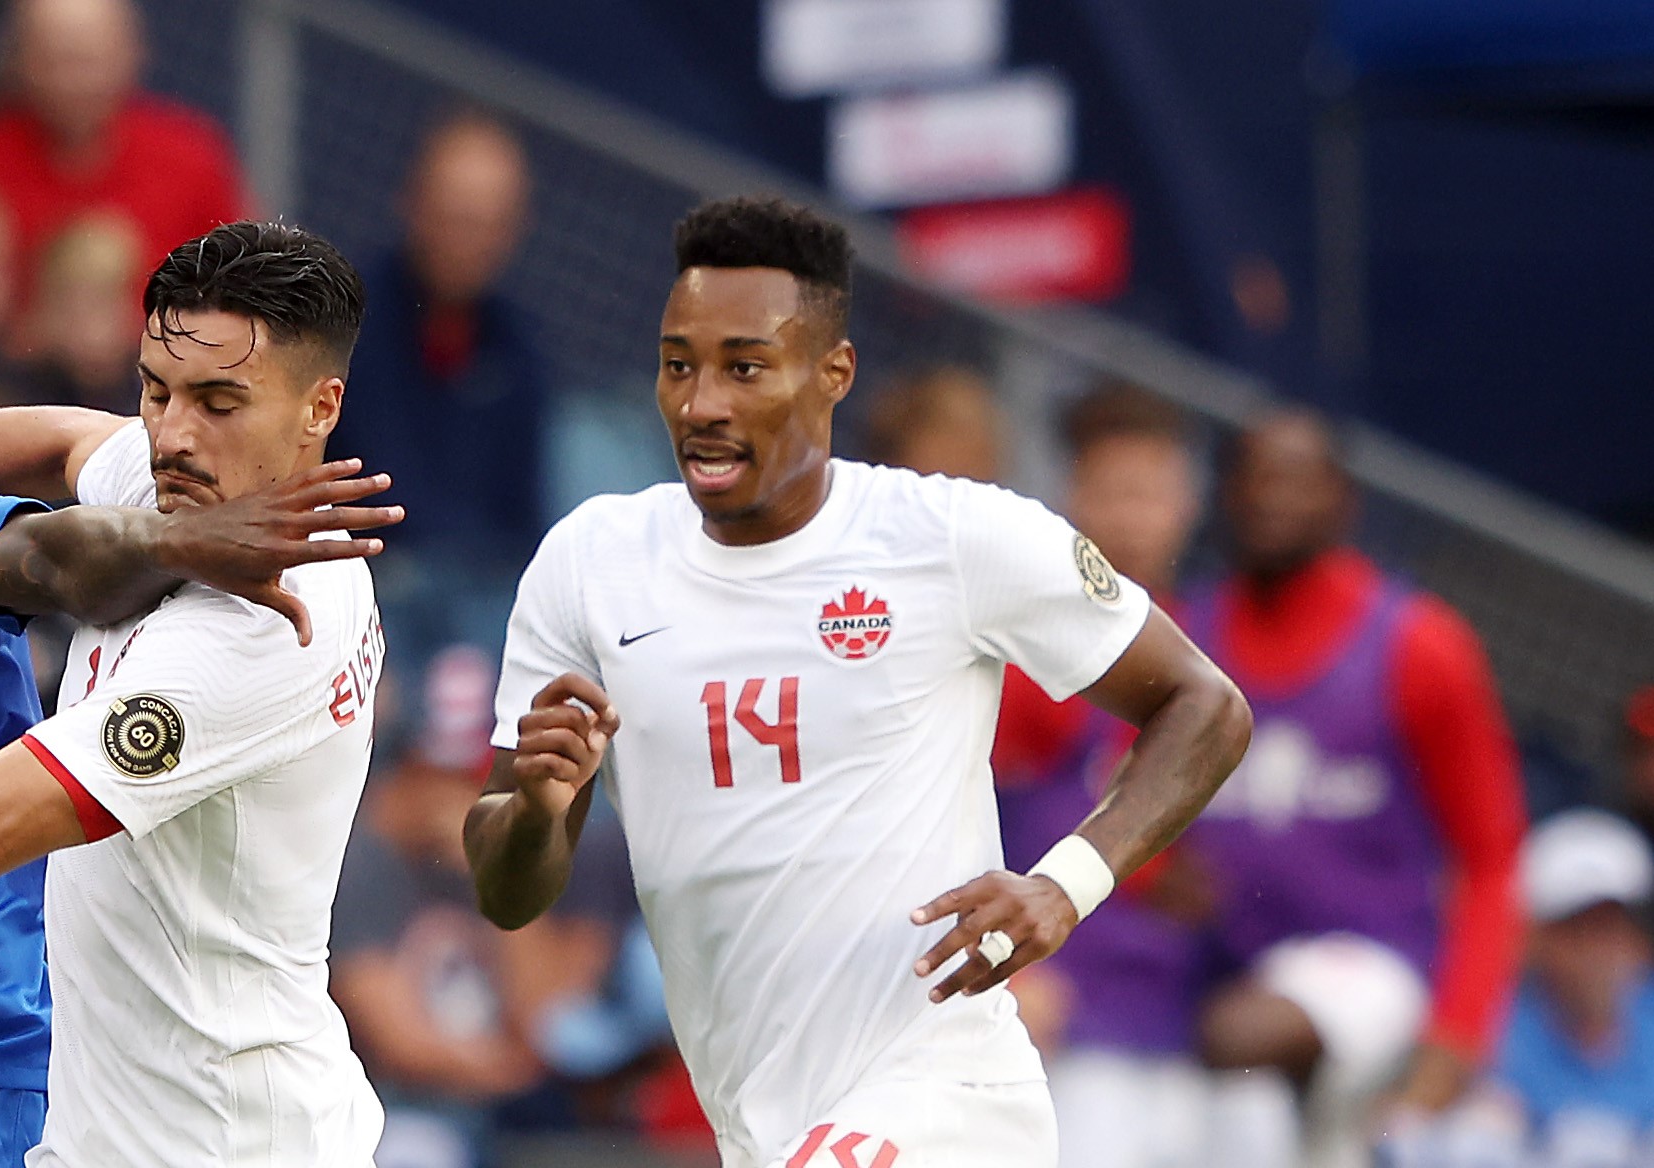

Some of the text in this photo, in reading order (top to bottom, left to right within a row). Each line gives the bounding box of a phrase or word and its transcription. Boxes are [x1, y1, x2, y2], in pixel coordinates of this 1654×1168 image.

[818, 617, 891, 631] CANADA
[140, 700, 178, 740] CONCACAF
[700, 676, 801, 788] 14
[132, 726, 155, 747] 60
